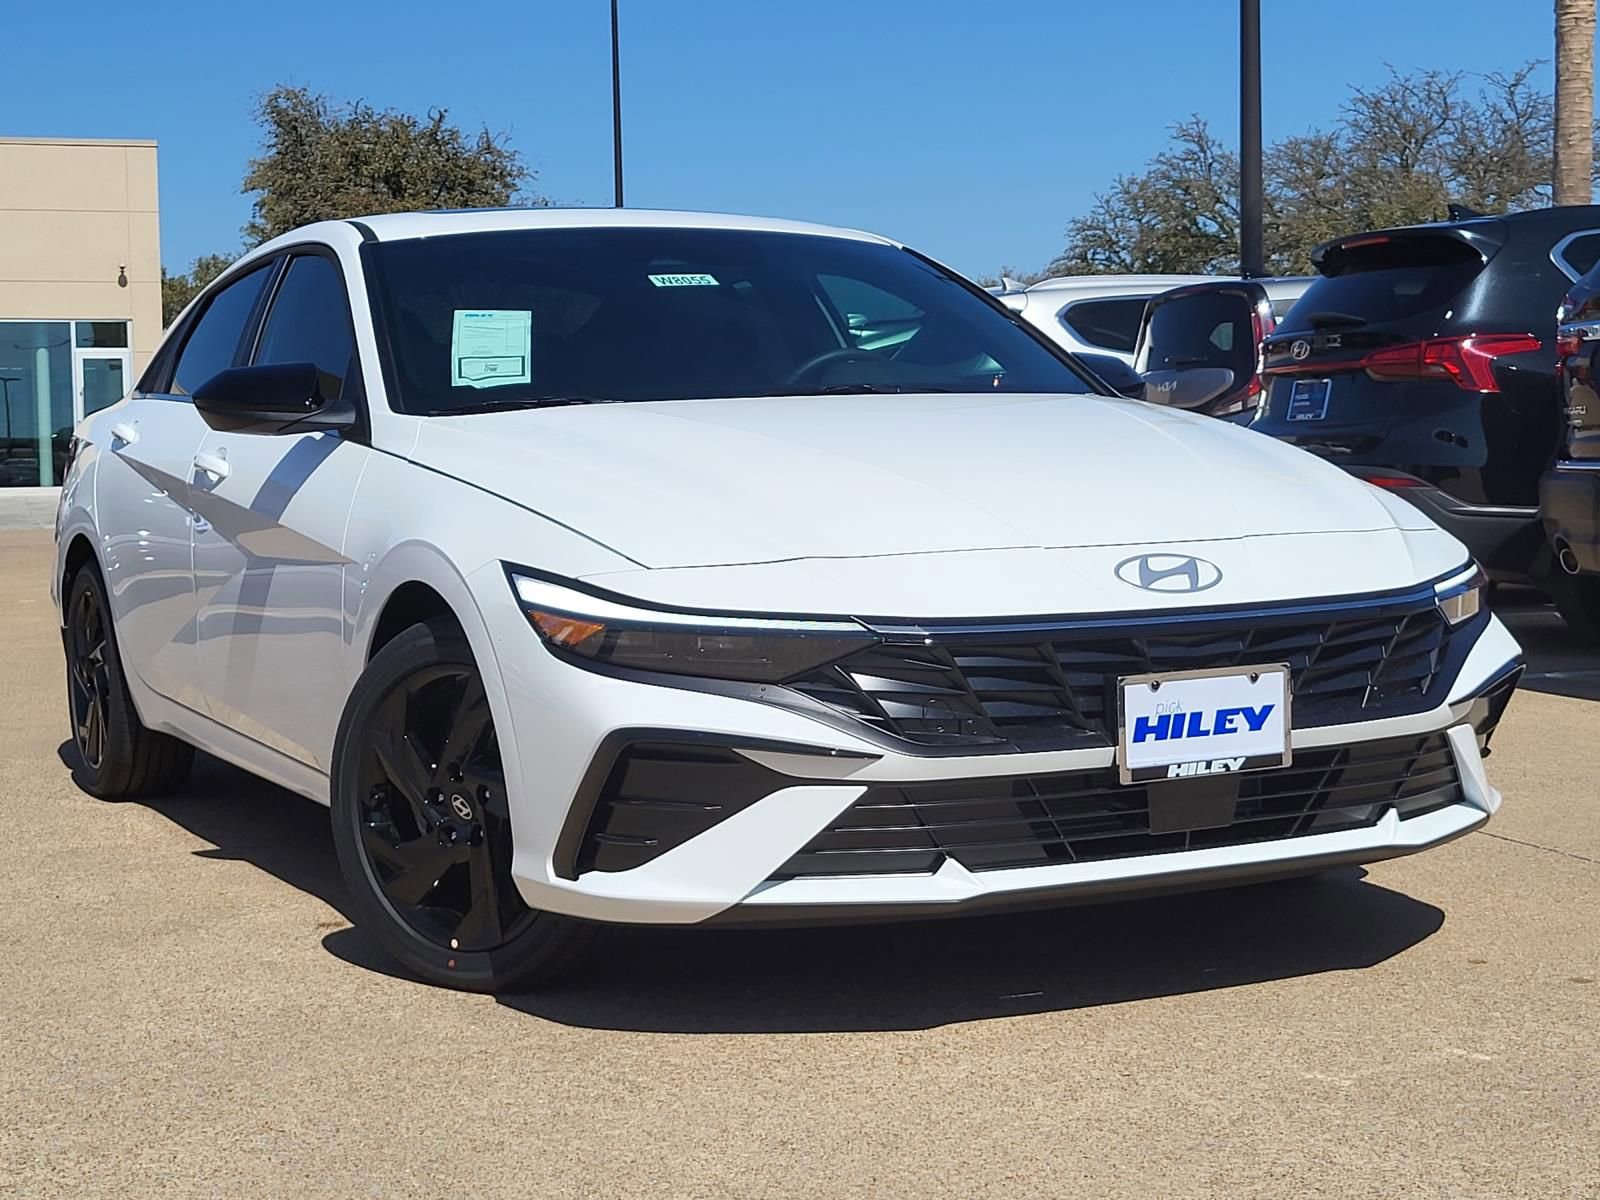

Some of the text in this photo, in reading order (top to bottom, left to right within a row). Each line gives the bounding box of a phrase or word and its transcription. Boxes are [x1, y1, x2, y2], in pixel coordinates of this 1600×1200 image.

[654, 275, 711, 285] W8055
[1157, 380, 1177, 392] KIA
[1155, 699, 1184, 716] pick
[1132, 704, 1276, 744] HILEY
[1167, 757, 1246, 778] HILEY
